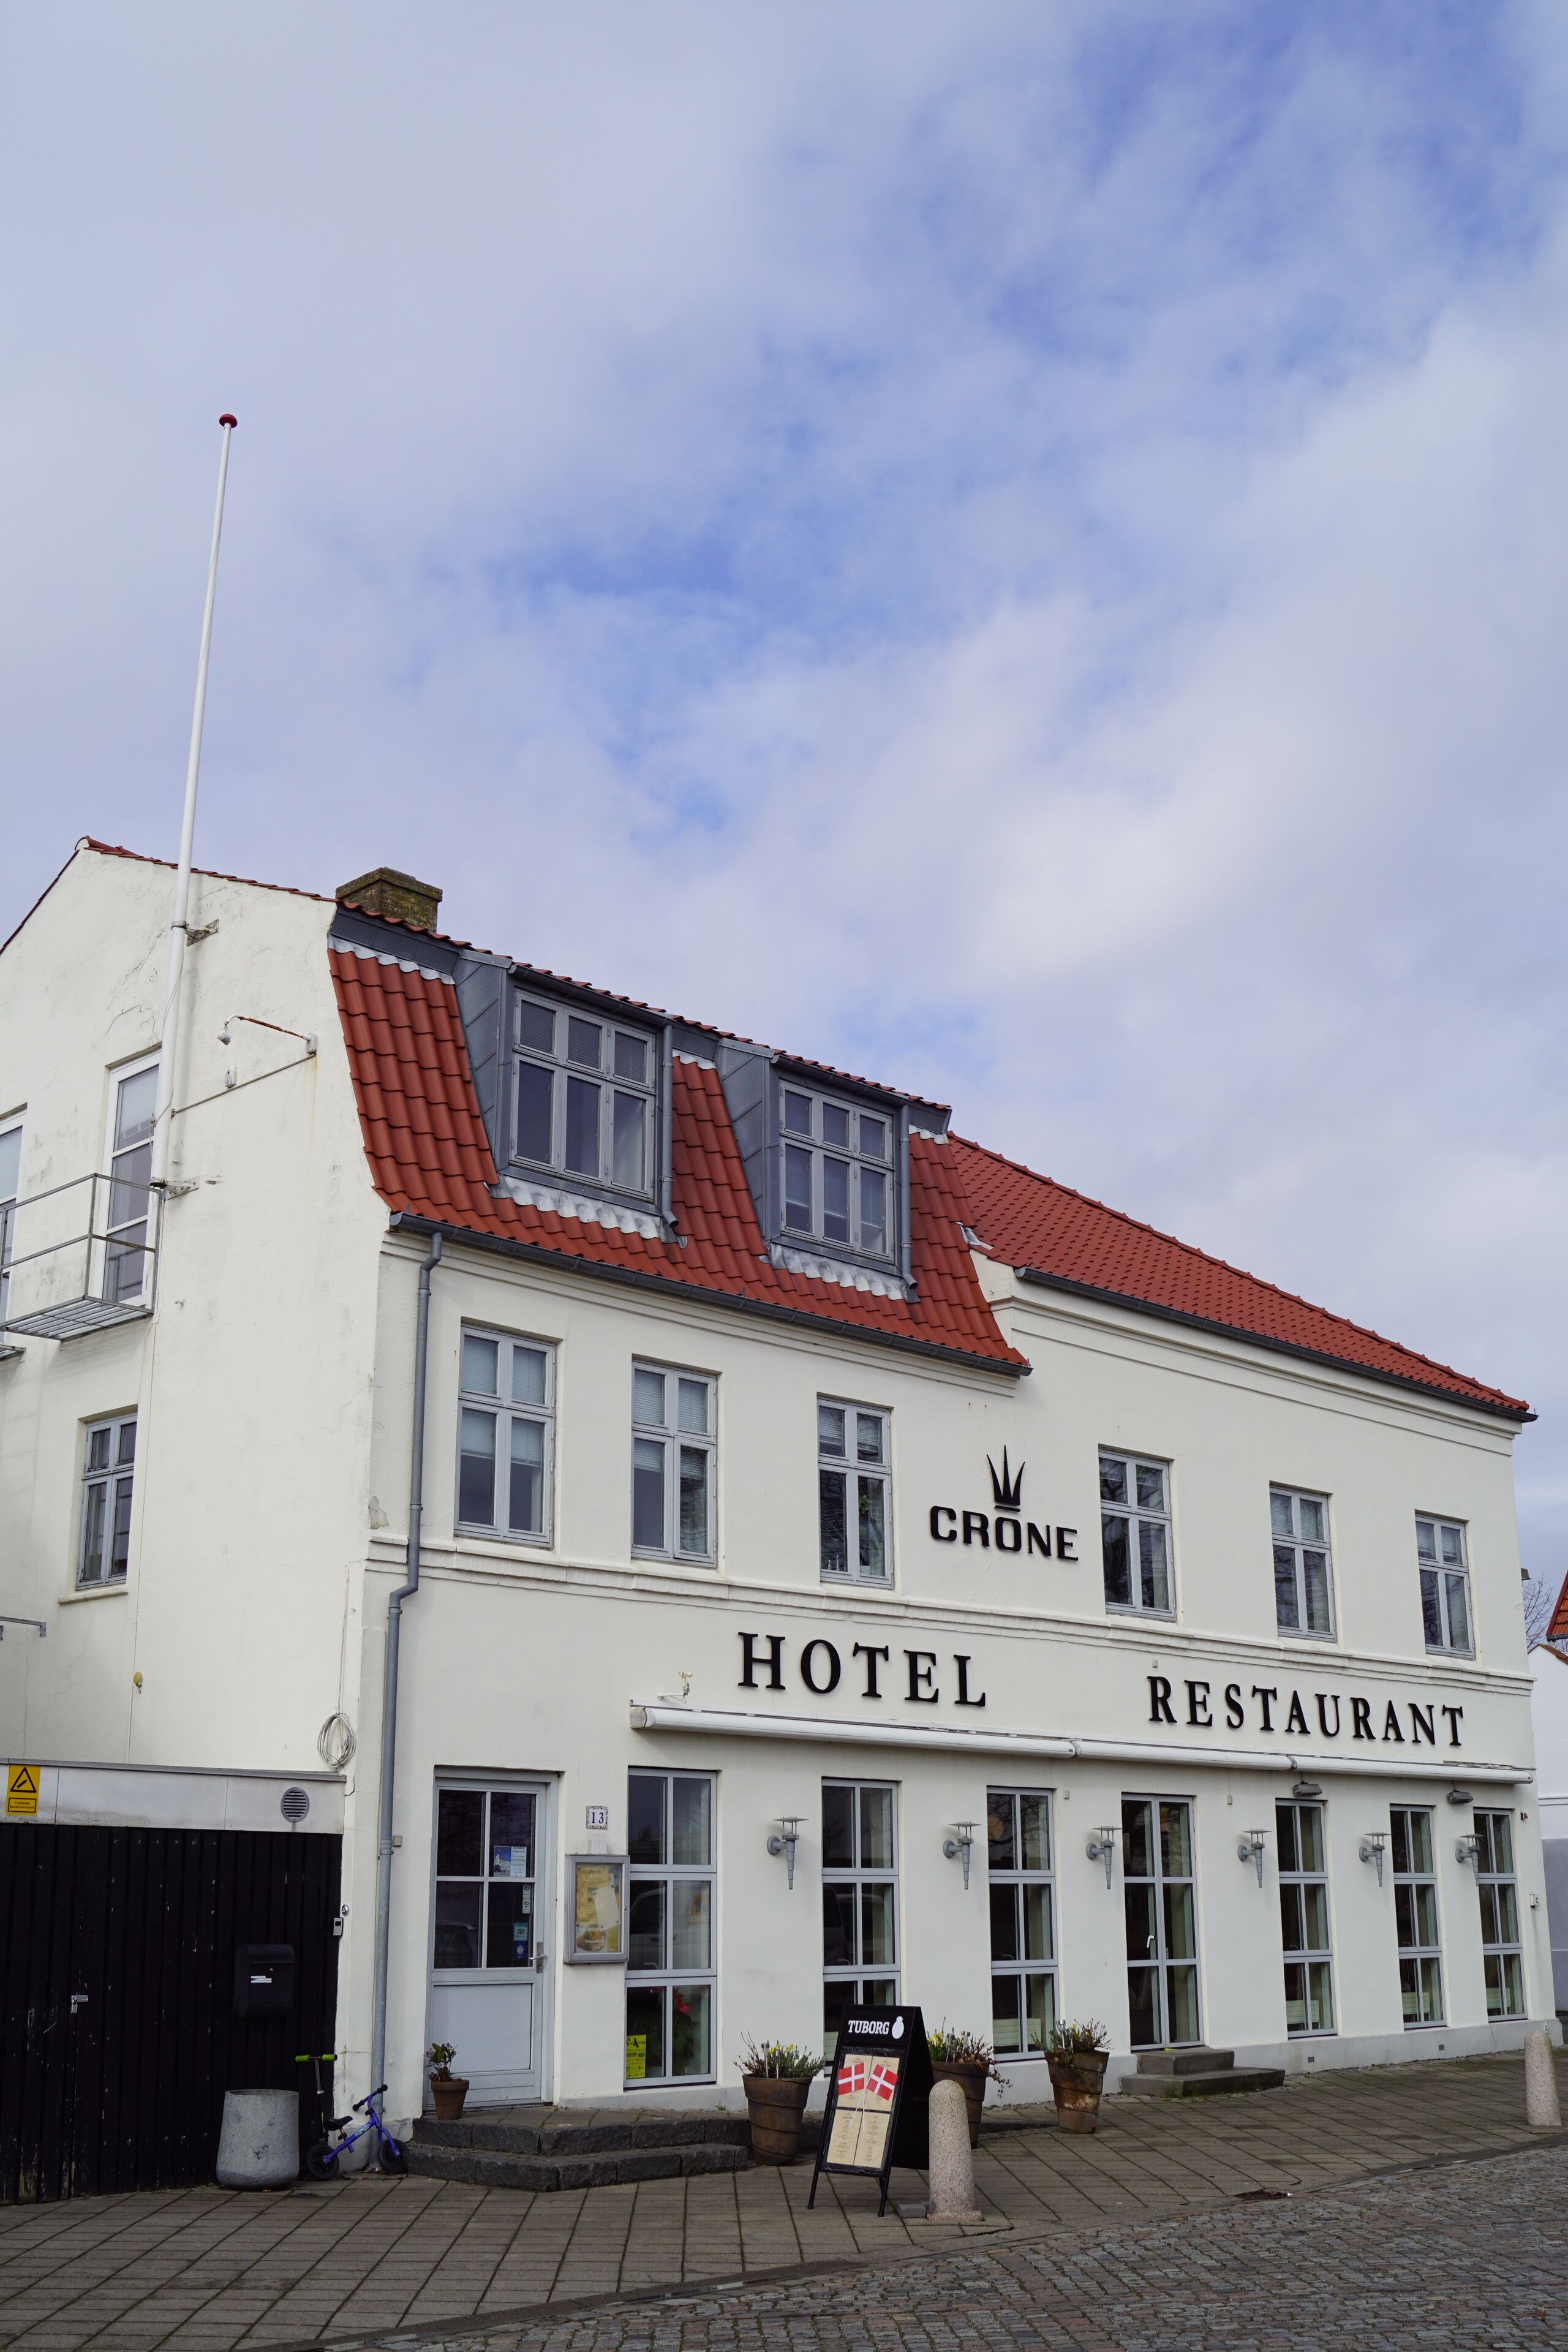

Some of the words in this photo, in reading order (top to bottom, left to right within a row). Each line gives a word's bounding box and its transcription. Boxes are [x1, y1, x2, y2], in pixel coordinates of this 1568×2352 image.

[930, 1505, 1079, 1561] CRONE
[737, 1632, 986, 1707] HOTEL
[1147, 1676, 1464, 1747] RESTAURANT
[591, 1811, 604, 1824] 13
[848, 2020, 890, 2035] TUBORG
